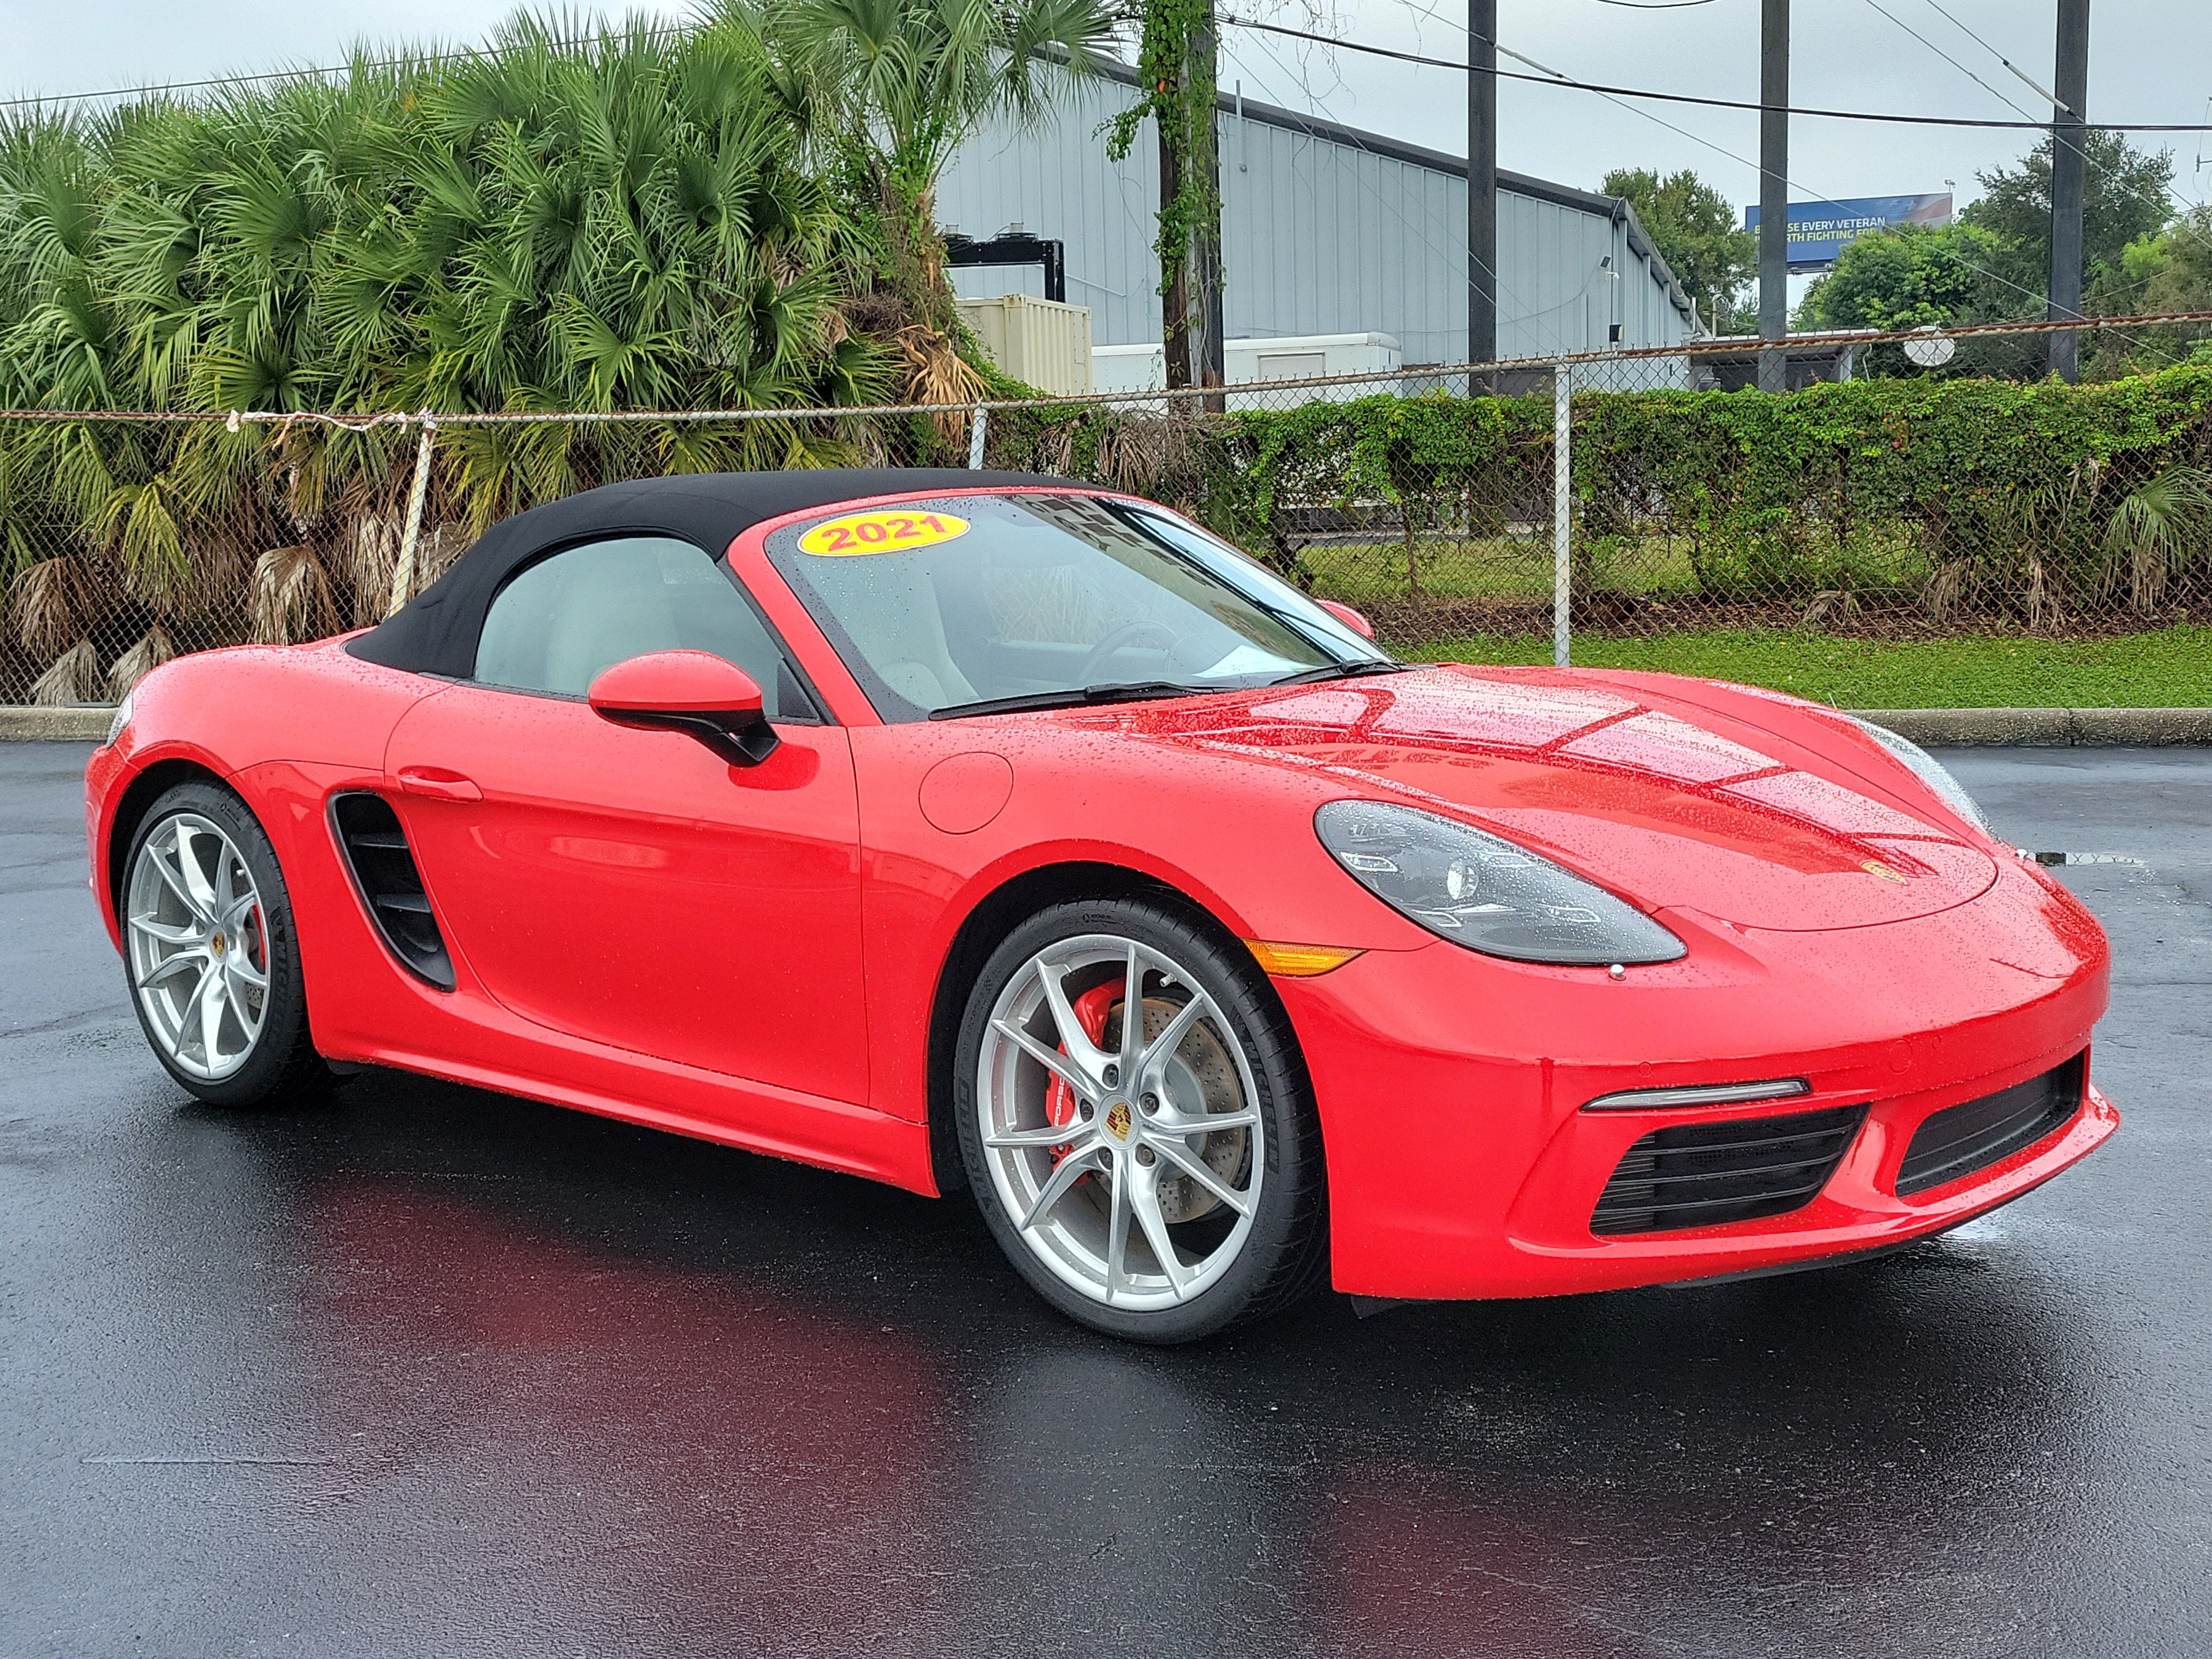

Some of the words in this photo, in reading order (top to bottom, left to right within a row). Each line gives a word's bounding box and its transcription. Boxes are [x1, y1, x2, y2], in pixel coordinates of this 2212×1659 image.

[1802, 220, 1835, 232] EVERY
[1836, 217, 1886, 229] VETERAN
[1807, 229, 1854, 241] FIGHTING
[821, 516, 948, 552] 2021
[1054, 1076, 1065, 1127] PORSC
